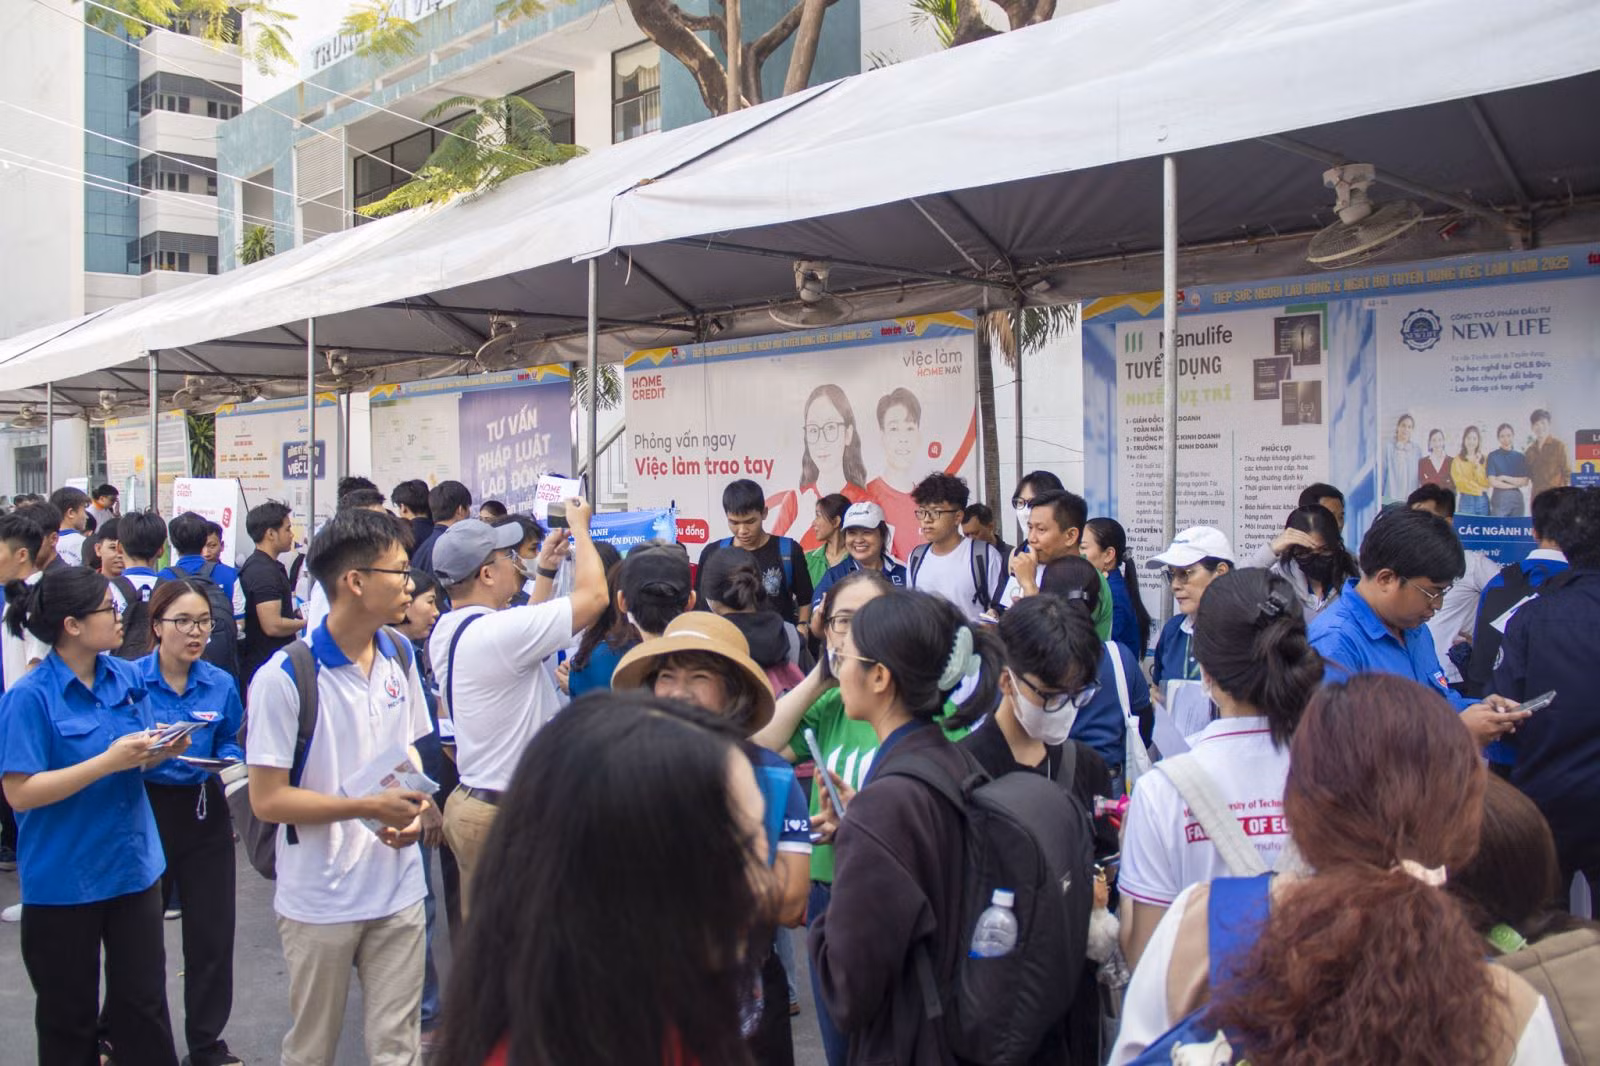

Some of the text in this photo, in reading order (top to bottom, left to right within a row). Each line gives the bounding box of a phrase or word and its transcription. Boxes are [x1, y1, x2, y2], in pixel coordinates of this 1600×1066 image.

[1541, 255, 1569, 270] 2025
[1450, 312, 1473, 321] CÔNG
[1452, 318, 1551, 341] NEW LIFE
[903, 348, 962, 368] việc làm
[917, 366, 962, 376] HOME NAY
[1125, 354, 1222, 380] TUYỂ DỤNG
[632, 375, 662, 388] HOME
[632, 388, 666, 400] CREDIT
[1126, 385, 1164, 406] NHIỀ
[486, 404, 538, 443] TƯ VẤN
[1134, 424, 1164, 433] TOÀN NĂN
[676, 430, 698, 448] vấn
[703, 432, 736, 452] ngay
[478, 433, 551, 474] PHÁP LUẬT
[1261, 444, 1292, 453] PHÚC LỢI
[634, 455, 774, 480] Việc làm trao tay
[539, 483, 561, 494] HOME
[537, 490, 561, 502] CREDIT
[1458, 524, 1521, 536] CÁC NGÀNH
[1248, 799, 1284, 809] of Techn
[800, 820, 809, 832] 2
[1249, 819, 1268, 833] OF
